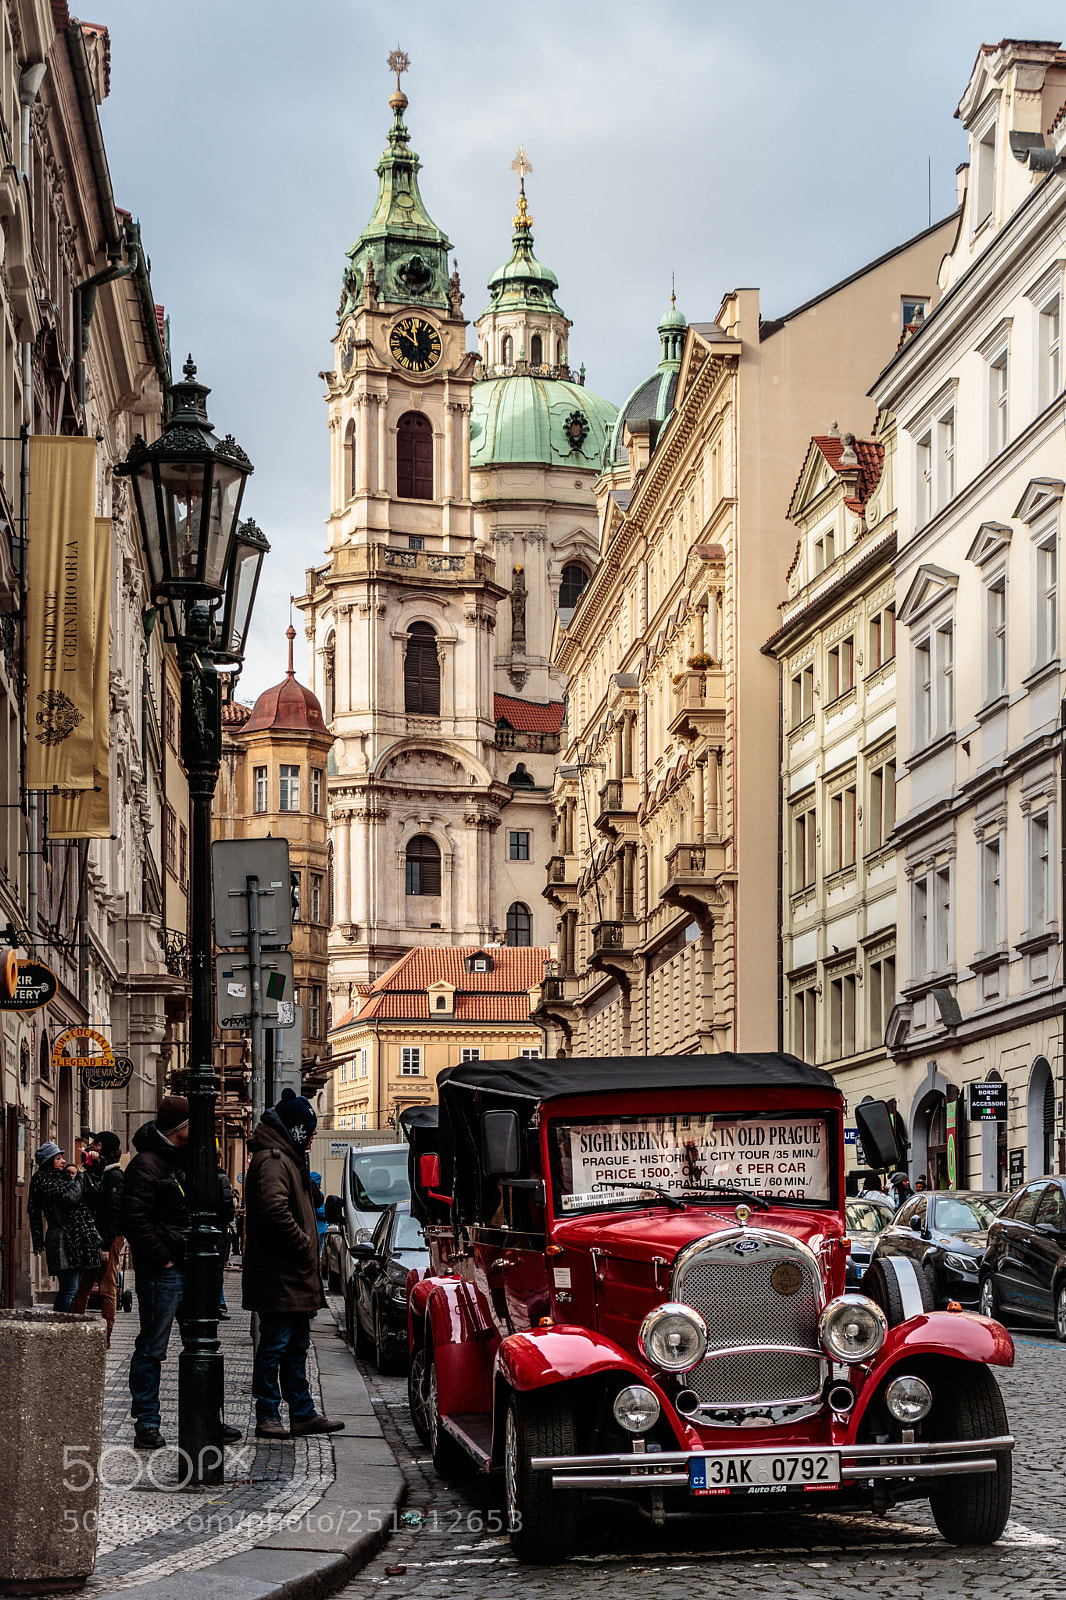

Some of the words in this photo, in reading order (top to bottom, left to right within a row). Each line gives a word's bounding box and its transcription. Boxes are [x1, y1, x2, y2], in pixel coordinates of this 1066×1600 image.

[65, 541, 78, 582] ORLA
[61, 586, 78, 657] ČERNÉHO
[44, 591, 57, 672] RESIDENCE
[64, 662, 77, 672] U
[53, 1037, 67, 1056] PUB
[70, 1028, 112, 1058] COCKTAIL
[85, 1068, 113, 1077] BOHEMIA
[580, 1130, 669, 1153] SIGHTSEEING
[720, 1126, 735, 1147] IN
[738, 1126, 765, 1146] OLD
[769, 1125, 820, 1145] PRAGUE
[582, 1156, 630, 1167] PRAGUE
[640, 1152, 707, 1164] HISTORIL
[710, 1151, 735, 1161] CITY
[738, 1150, 770, 1160] TOUR
[792, 1148, 820, 1159] MIN./
[596, 1168, 637, 1180] PRICE
[641, 1167, 678, 1179] 1500,-
[681, 1165, 708, 1176] CK
[736, 1163, 743, 1175] €
[747, 1163, 774, 1174] PER
[777, 1162, 806, 1174] CAR
[591, 1183, 615, 1193] CITY
[622, 1181, 652, 1190] UR
[668, 1178, 715, 1189] PRAGUE
[718, 1177, 761, 1187] CASTLE
[784, 1175, 813, 1187] MIN./
[739, 1241, 756, 1250] Ford
[710, 1459, 753, 1484] 3AK
[772, 1456, 829, 1481] 0792
[693, 1477, 705, 1485] CZ
[747, 1486, 769, 1494] Auto
[769, 1485, 787, 1493] ESA
